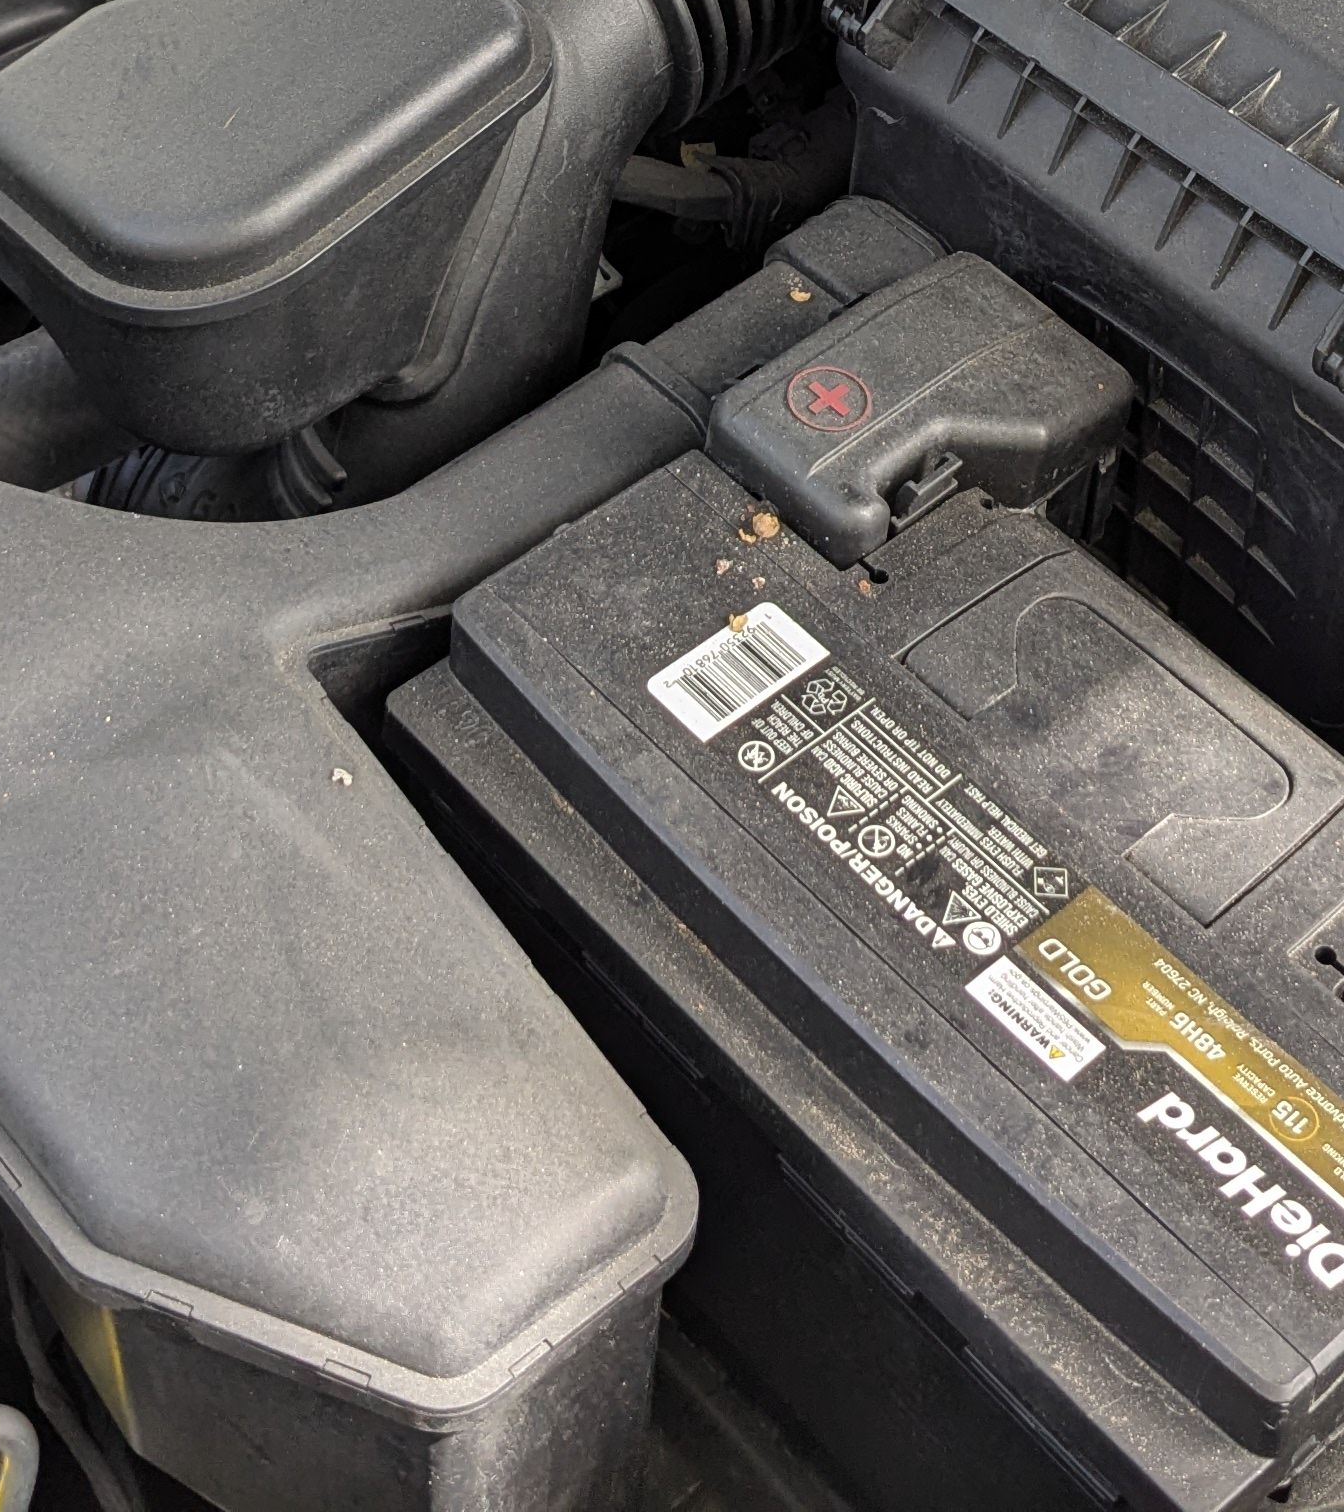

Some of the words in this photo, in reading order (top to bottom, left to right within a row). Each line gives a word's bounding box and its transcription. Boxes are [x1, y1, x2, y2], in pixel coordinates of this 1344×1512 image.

[763, 611, 772, 620] 1
[717, 622, 757, 652] 92350
[680, 648, 720, 677] 76810
[661, 678, 673, 689] 2
[749, 715, 766, 729] OF
[765, 713, 792, 736] REACH
[767, 698, 806, 732] CHILDREN.
[867, 704, 897, 730] OPEN.
[758, 723, 779, 741] OUT
[771, 735, 795, 755] KEEP
[785, 730, 804, 747] THE
[799, 726, 815, 740] OF
[828, 728, 862, 757] BURNS.
[846, 716, 912, 774] INSTRUCTIONS.
[890, 725, 909, 740] OR
[902, 735, 922, 752] TIP
[809, 744, 829, 761] CAN
[819, 737, 866, 778] BLINDNESS
[915, 747, 939, 767] NOT
[821, 756, 846, 778] ACID
[854, 752, 889, 781] SEVERE
[932, 762, 952, 779] DO
[837, 772, 879, 808] SULFURIC
[859, 772, 889, 799] CAUSE
[881, 776, 899, 791] OR
[905, 769, 933, 794] READ
[962, 781, 987, 803] FAST.
[894, 805, 929, 836] FLAMES
[899, 793, 940, 829] SMOKING
[934, 796, 984, 840] IMMEDIATELY
[979, 797, 1005, 819] HELP
[883, 814, 919, 845] SPARKS
[984, 824, 1017, 852] WATER.
[997, 813, 1035, 846] MEDICAL
[769, 780, 938, 935] DANGER/POISON
[894, 842, 915, 859] NO
[937, 845, 957, 862] CAN
[945, 834, 975, 860] INJURY.
[978, 835, 1002, 856] EYES
[1009, 846, 1035, 869] WITH
[1027, 840, 1049, 858] GET
[949, 857, 984, 887] GASES
[968, 855, 985, 869] OR
[995, 851, 1025, 877] FLUSH
[957, 881, 989, 909] EYES.
[978, 864, 1019, 899] BLINDNESS
[976, 881, 1030, 928] EXPLOSIVE
[1012, 894, 1040, 919] CAUSE
[982, 903, 1020, 936] SHIELD
[1035, 935, 1114, 1003] GOLD
[1152, 957, 1192, 991] 27604
[1140, 979, 1176, 1011] NUMBER
[1144, 996, 1168, 1016] PART
[1186, 986, 1208, 1005] NC
[984, 988, 1052, 1049] WARNING:
[1202, 1000, 1250, 1038] Raleigh,
[1167, 1009, 1229, 1063] 48H6
[1244, 1035, 1282, 1068] Parts,
[1230, 1070, 1269, 1104] RESERVE
[1234, 1061, 1277, 1098] CAPACITY
[1275, 1062, 1309, 1091] Auto
[1269, 1098, 1312, 1134] 115
